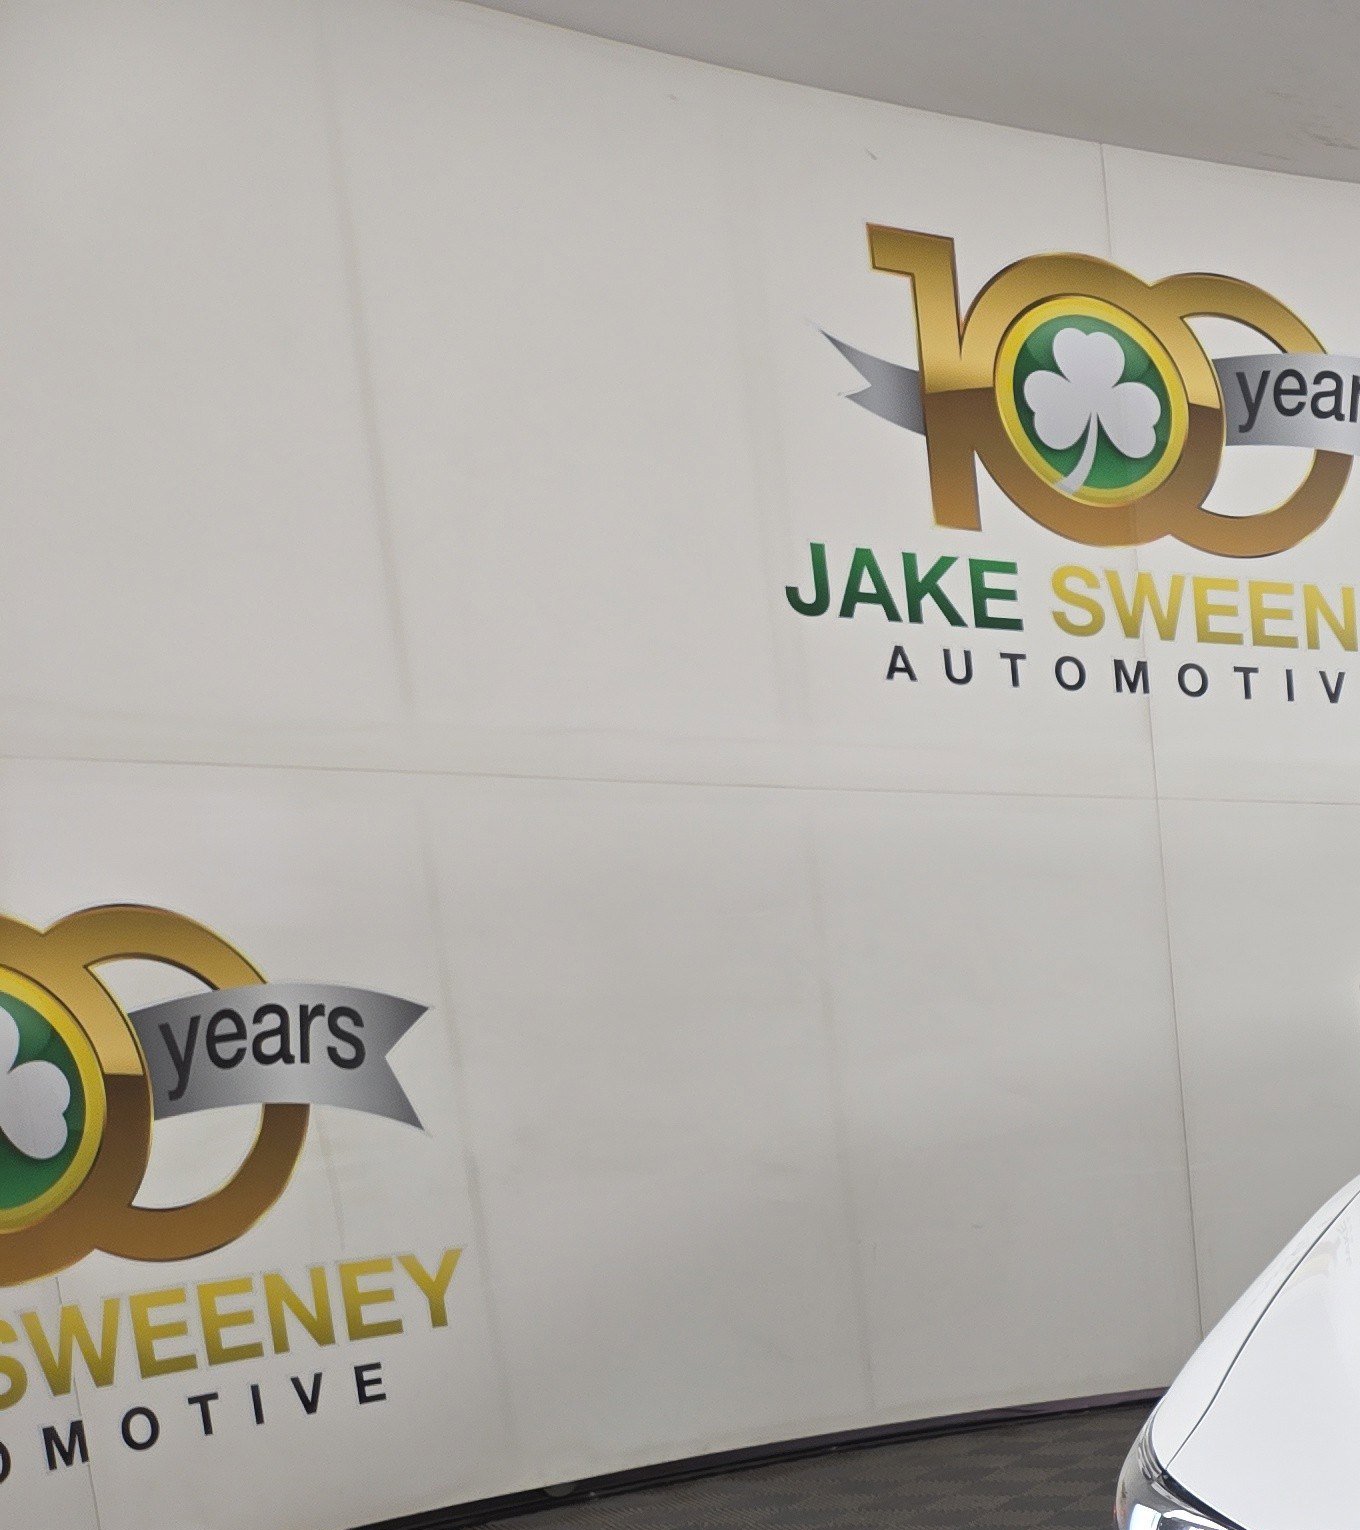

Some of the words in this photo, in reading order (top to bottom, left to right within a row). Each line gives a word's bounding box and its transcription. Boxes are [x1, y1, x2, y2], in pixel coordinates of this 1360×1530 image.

[866, 221, 1354, 559] 100
[785, 542, 1025, 631] JAKE
[158, 1003, 367, 1099] years
[0, 1362, 387, 1485] MOTIVE
